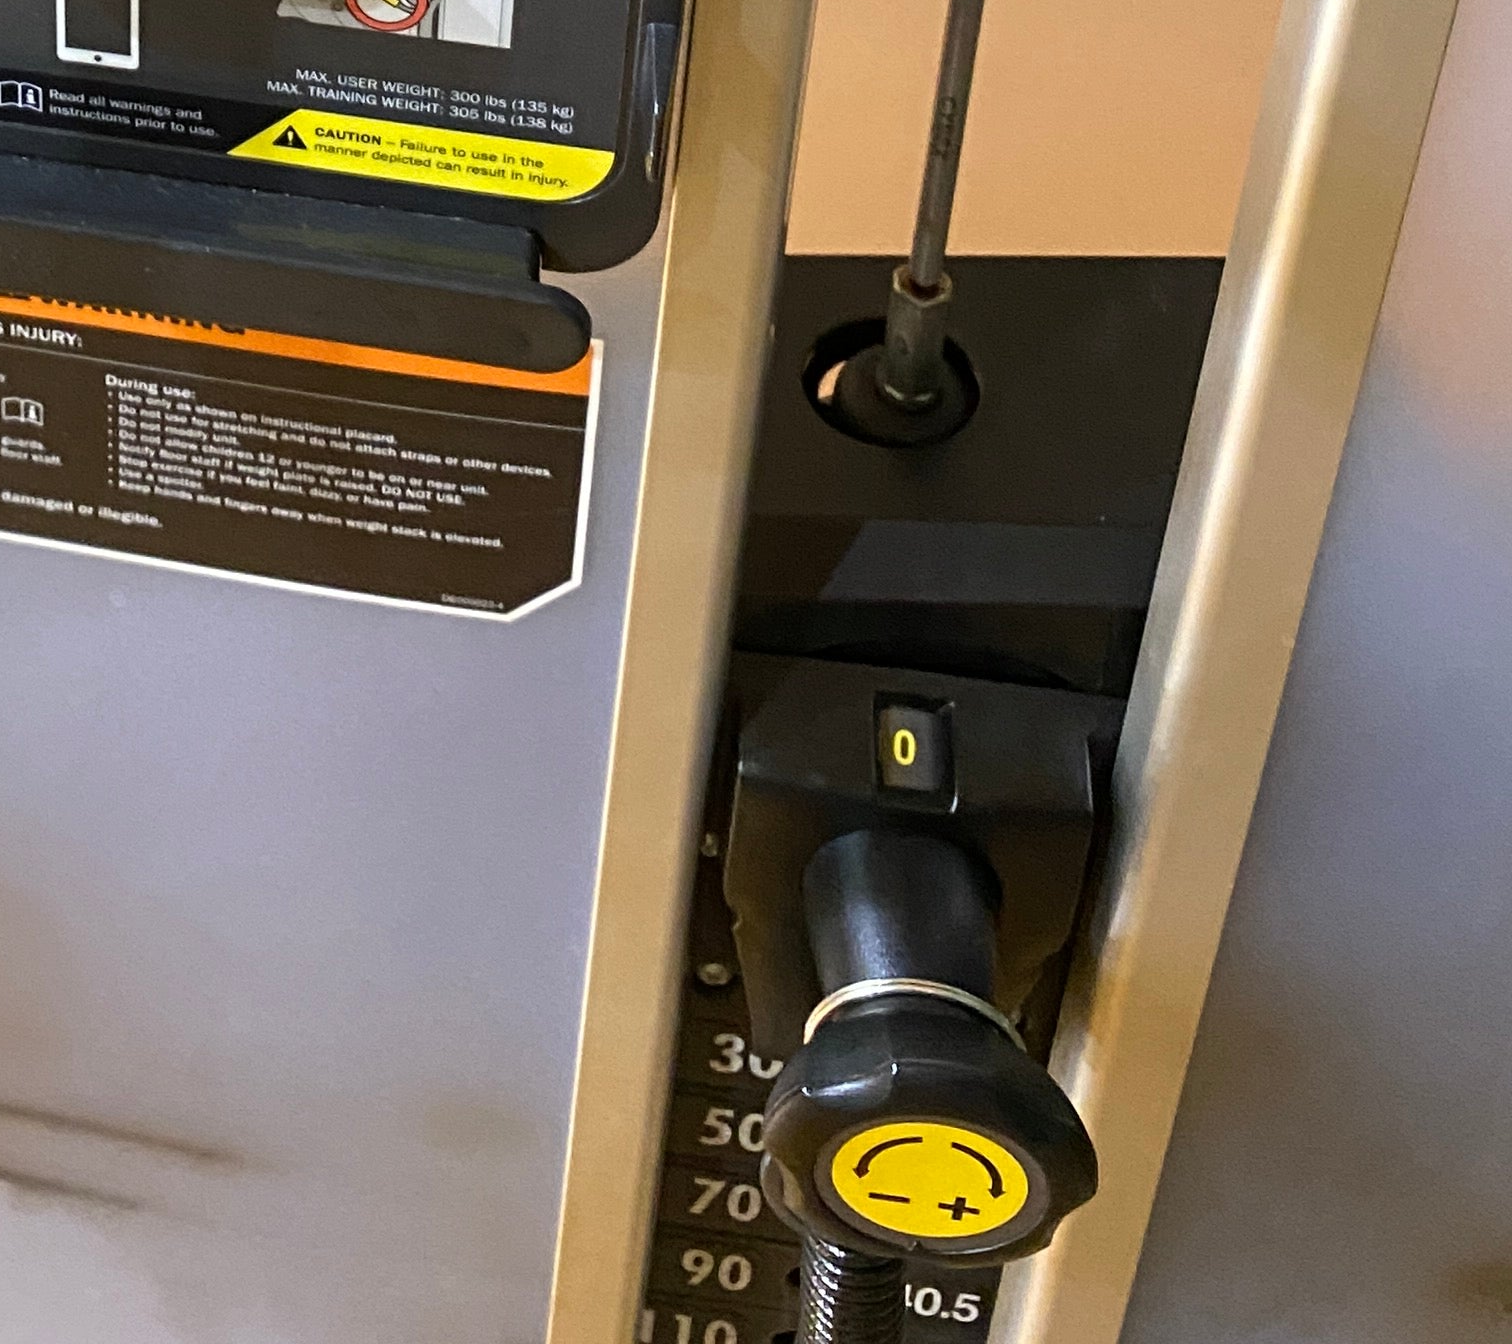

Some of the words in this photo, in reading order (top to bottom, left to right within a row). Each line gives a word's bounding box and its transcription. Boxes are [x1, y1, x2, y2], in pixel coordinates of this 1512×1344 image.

[49, 88, 85, 104] Read
[88, 95, 106, 107] all
[109, 99, 171, 117] warnings
[175, 109, 203, 121] and
[266, 80, 303, 95] MAX.
[307, 85, 378, 106] TRAINING
[381, 95, 444, 115] WEIGHT:
[448, 105, 480, 120] 305
[484, 110, 506, 124] lbs
[510, 114, 547, 129] (138
[550, 119, 573, 135] kg)
[295, 68, 332, 84] MAX.
[337, 74, 378, 91] USER
[382, 80, 445, 100] WEIGHT:
[449, 90, 481, 105] 300
[485, 94, 507, 109] lbs
[511, 99, 548, 114] (135
[552, 103, 575, 119] kg)
[49, 104, 131, 125] instructions
[134, 118, 166, 130] prior
[170, 121, 185, 133] to
[188, 125, 218, 137] use.
[313, 143, 368, 159] manner
[371, 150, 432, 168] depicted
[435, 160, 462, 172] can
[466, 165, 506, 179] result
[510, 169, 524, 181] in
[528, 172, 569, 189] injury.
[314, 127, 382, 146] CAUTION
[399, 138, 447, 155] Failure
[451, 146, 467, 158] to
[470, 151, 498, 163] use
[502, 153, 516, 165] in
[520, 156, 545, 169] the
[9, 323, 83, 348] INJURY:
[105, 373, 159, 396] During
[162, 385, 196, 400] use:
[117, 390, 143, 404] Use
[145, 396, 172, 411] only
[194, 404, 238, 420] shown
[260, 414, 342, 436] instructional
[344, 429, 398, 445] placard.
[139, 408, 162, 420] not
[164, 412, 188, 424] use
[191, 415, 210, 428] for
[212, 421, 278, 441] stretching
[280, 432, 306, 444] and
[329, 439, 352, 452] not
[354, 443, 397, 458] attach
[400, 450, 442, 464] straps
[462, 458, 498, 471] other
[500, 462, 551, 478] devices.
[0, 490, 74, 513] damaged
[77, 504, 94, 516] or
[97, 506, 163, 528] illegible.
[894, 729, 917, 766] 0
[698, 1108, 766, 1153] 50
[688, 1178, 762, 1222] 70
[680, 1248, 753, 1291] 90
